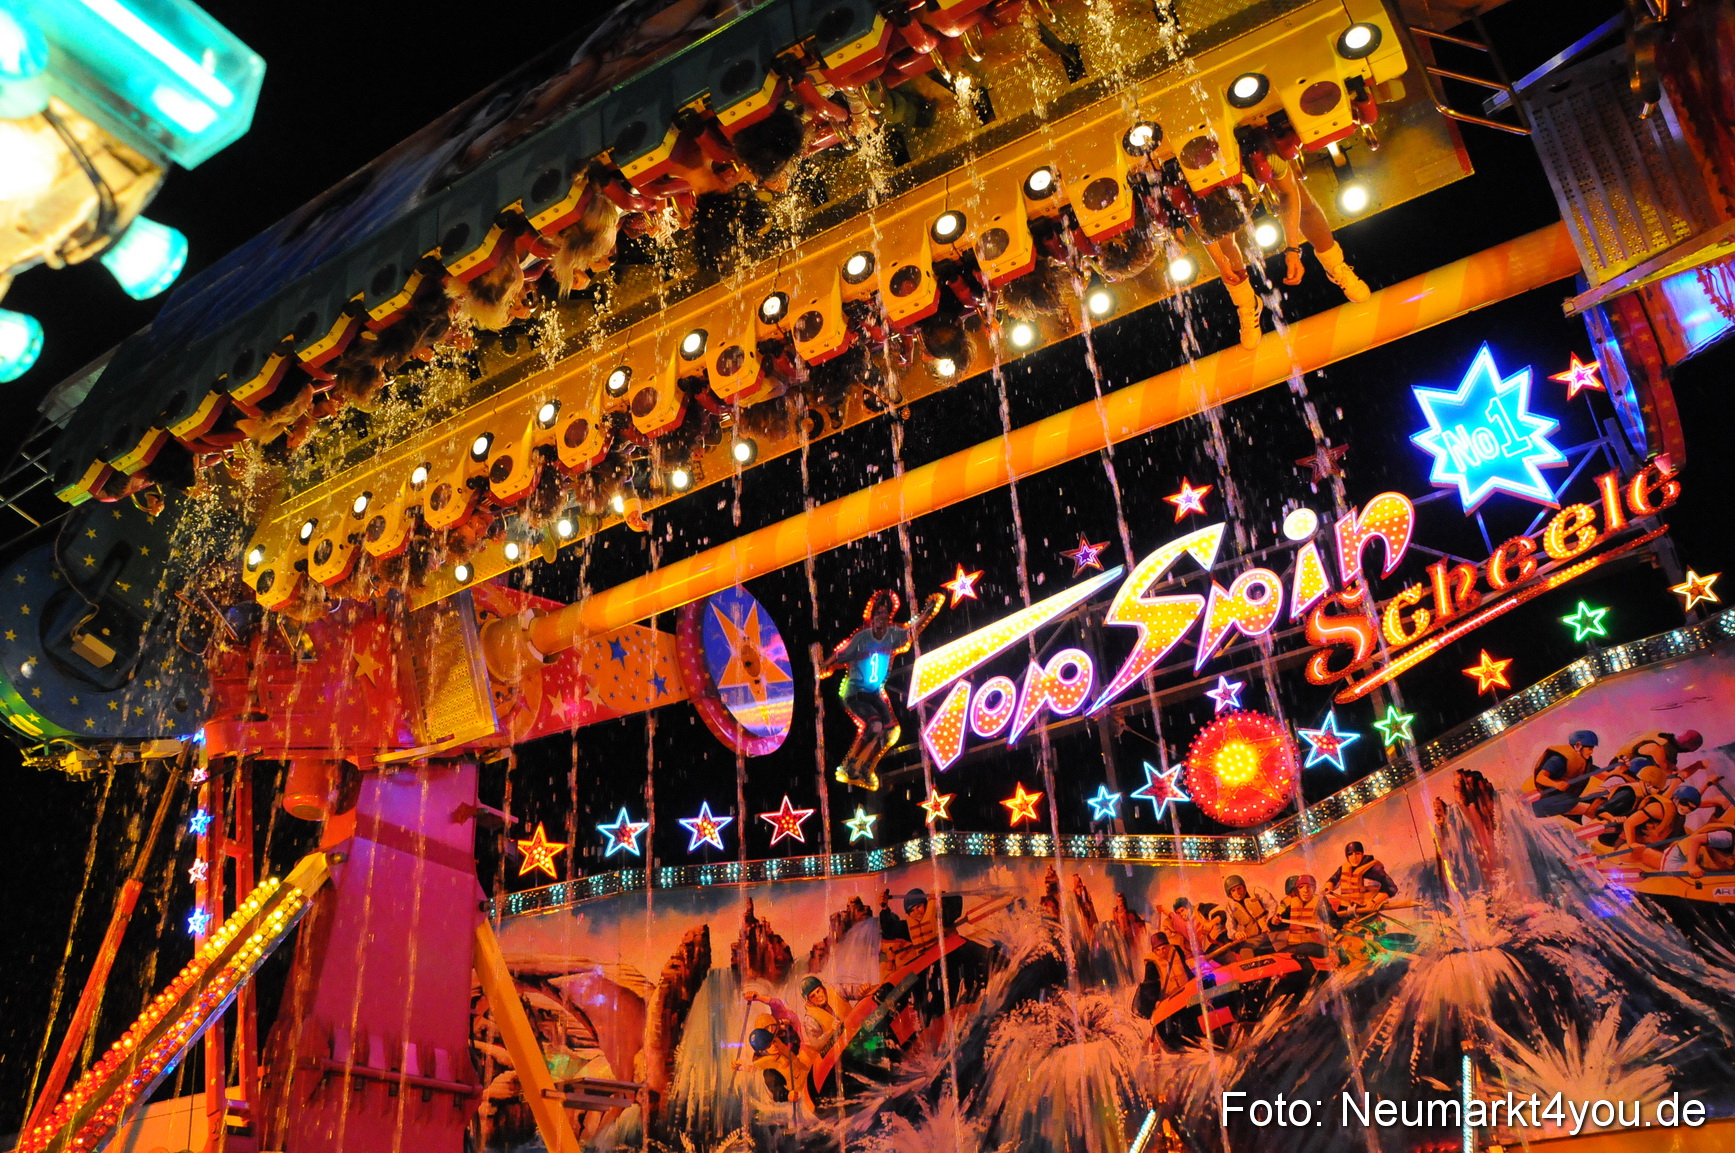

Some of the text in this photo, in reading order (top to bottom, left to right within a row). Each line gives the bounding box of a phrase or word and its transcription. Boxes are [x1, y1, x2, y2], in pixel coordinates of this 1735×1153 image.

[869, 652, 879, 683] 1
[1086, 491, 1416, 718] Spin
[1304, 462, 1682, 686] Scheele
